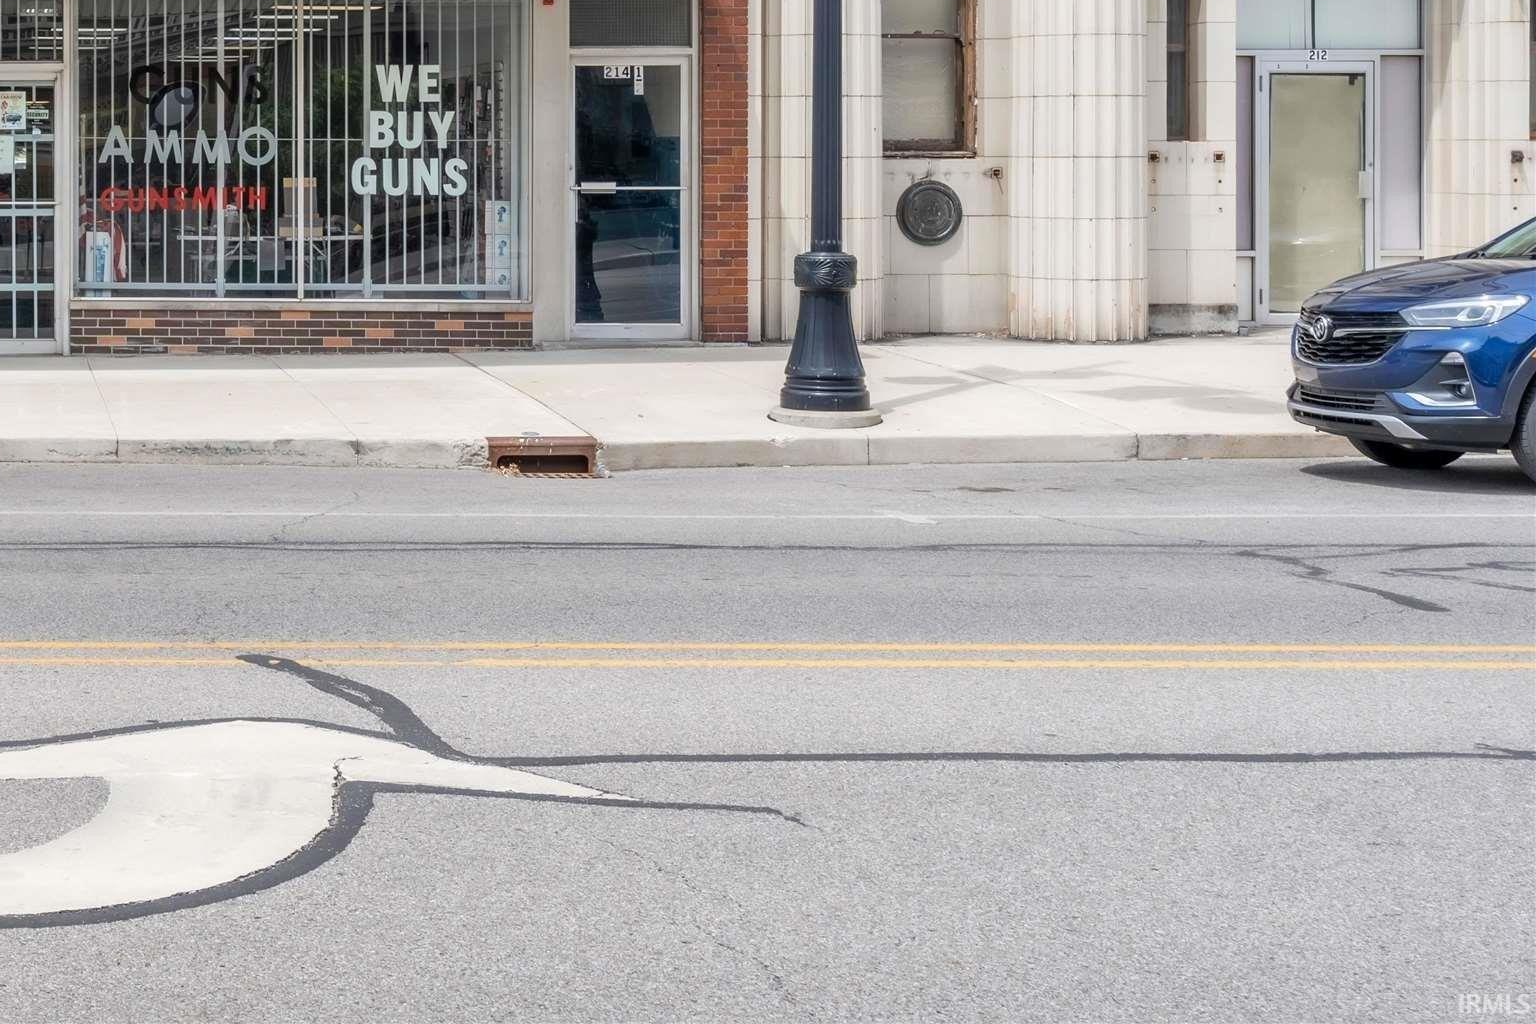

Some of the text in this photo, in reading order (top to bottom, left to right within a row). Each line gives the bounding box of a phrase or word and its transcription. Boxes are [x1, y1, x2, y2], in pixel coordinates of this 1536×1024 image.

[605, 66, 630, 78] 214
[1309, 50, 1328, 61] 212
[375, 64, 441, 102] WE
[98, 125, 278, 166] AMMO
[369, 110, 455, 149] BUY
[351, 157, 468, 196] GUNS
[100, 185, 267, 214] GUNSMITH
